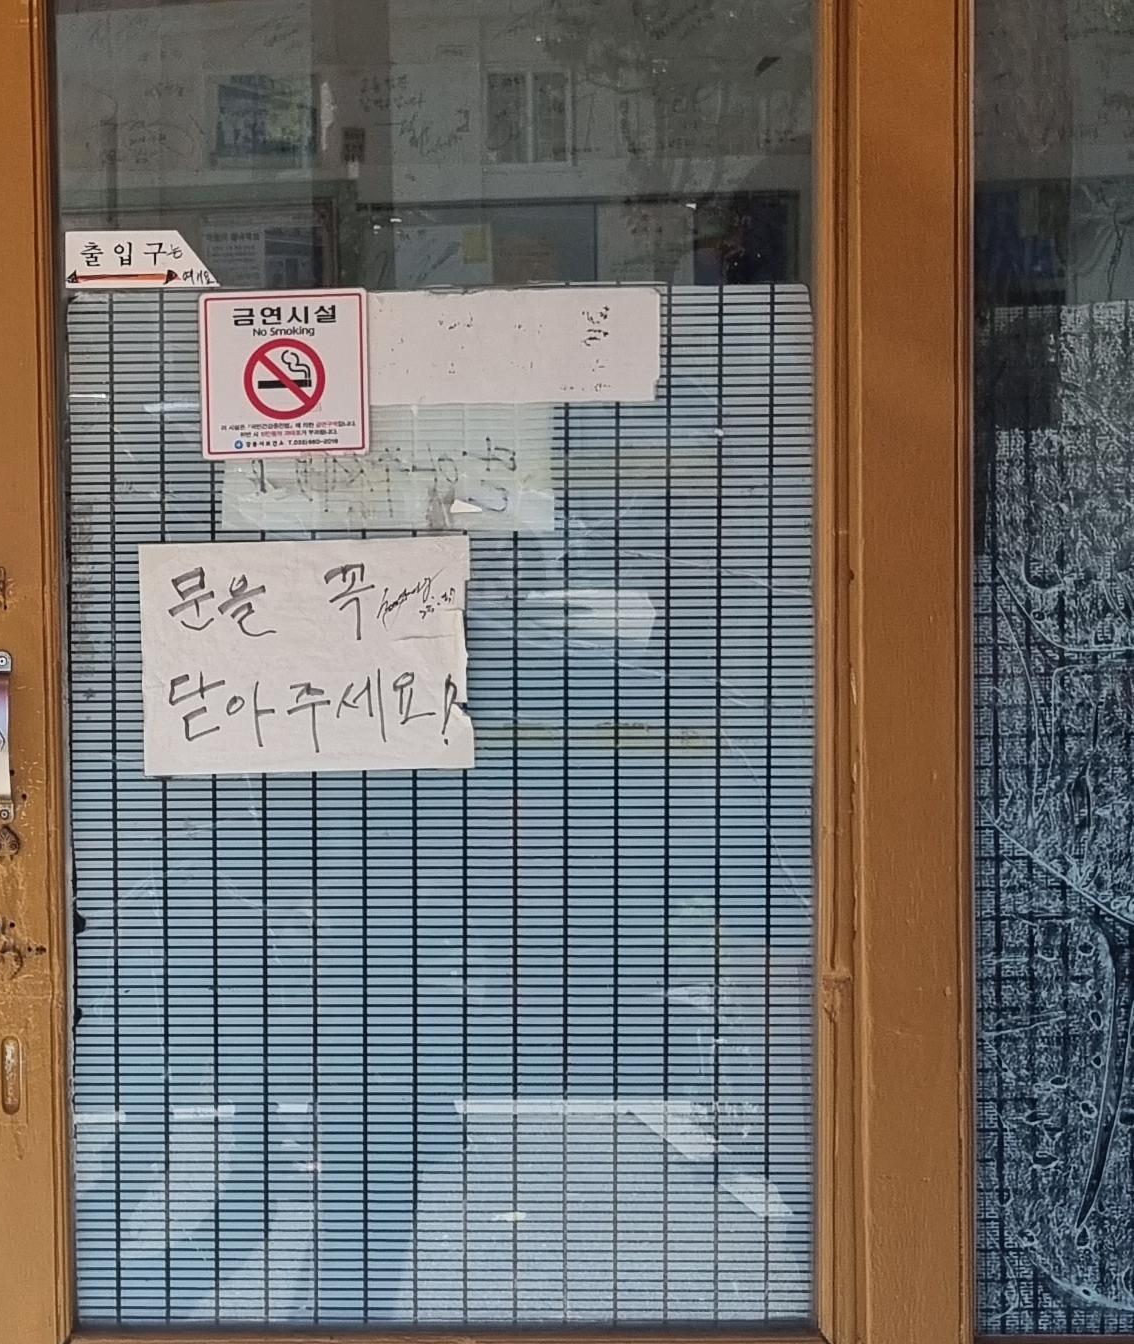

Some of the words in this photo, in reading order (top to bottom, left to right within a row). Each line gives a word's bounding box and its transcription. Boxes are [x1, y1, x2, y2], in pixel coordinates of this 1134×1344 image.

[232, 304, 337, 327] 금연시설
[252, 327, 267, 337] No
[270, 325, 315, 337] Smoking
[168, 567, 276, 637] 문을
[325, 563, 375, 641] 꼭
[168, 668, 465, 754] 닫아주세요!
